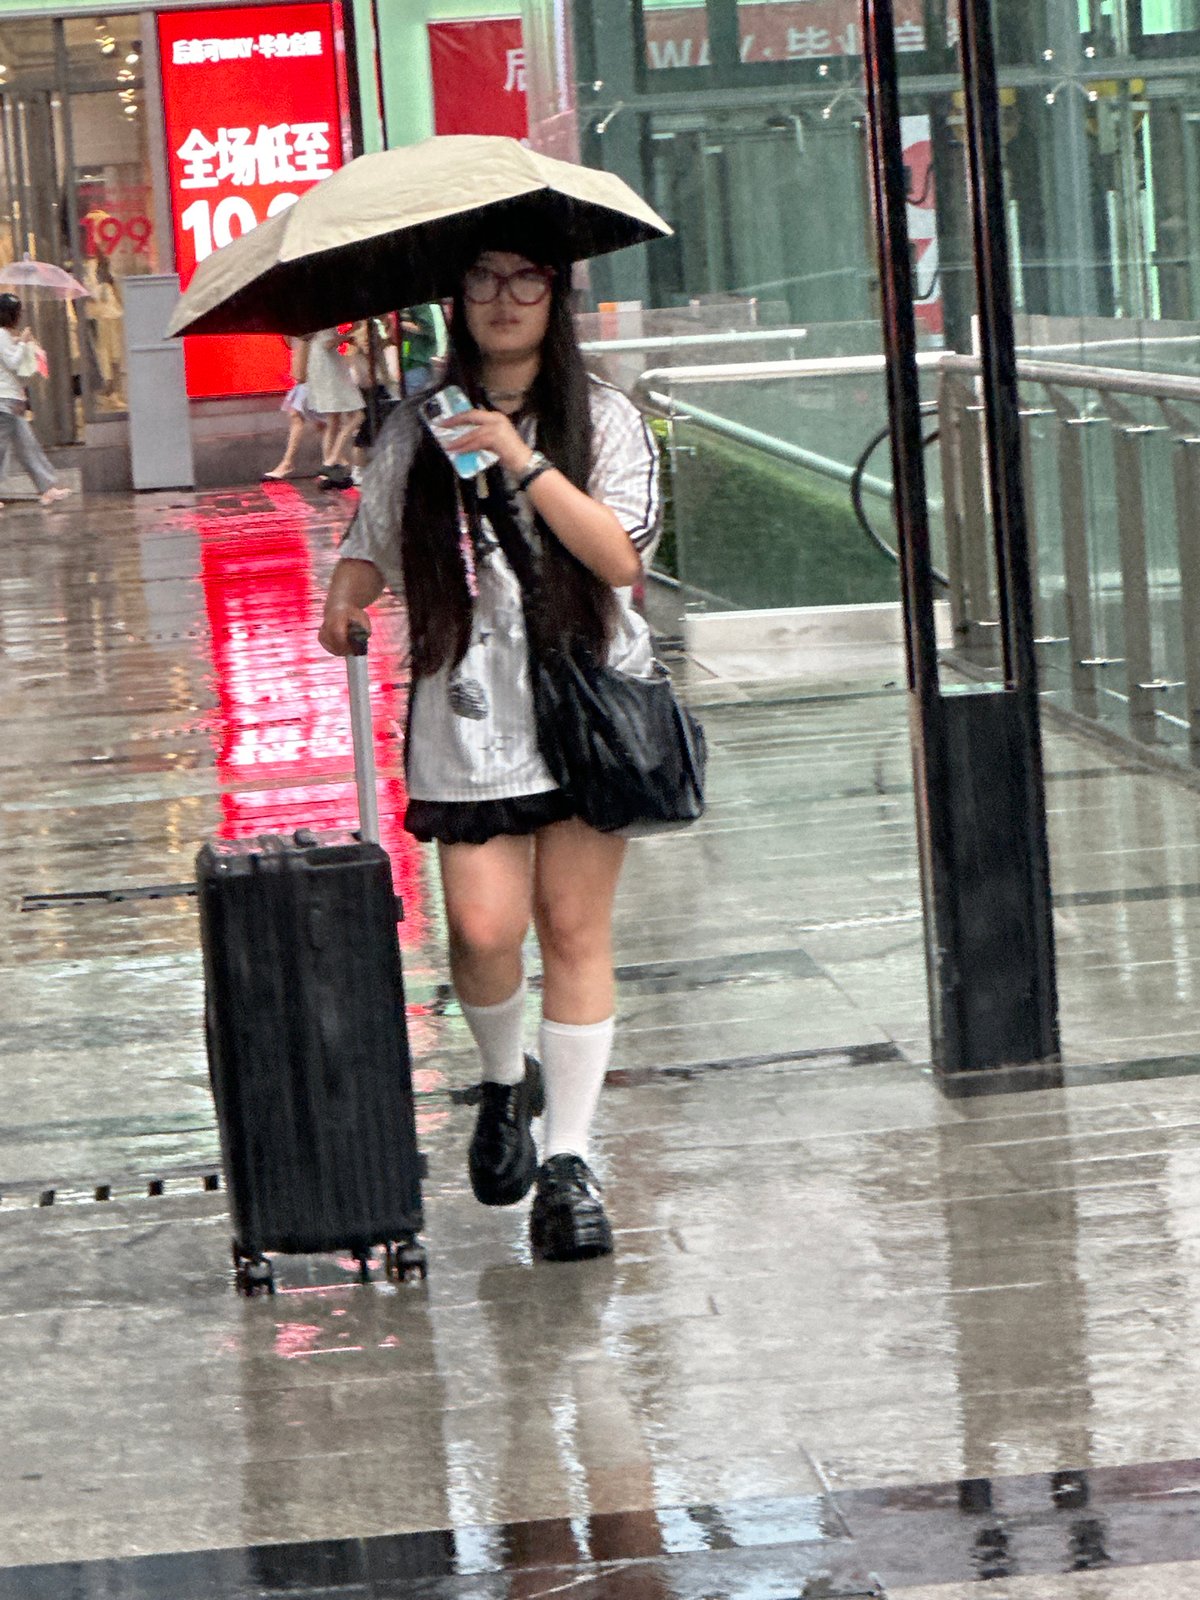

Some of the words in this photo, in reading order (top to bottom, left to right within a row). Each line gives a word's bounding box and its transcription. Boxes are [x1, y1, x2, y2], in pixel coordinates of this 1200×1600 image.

[176, 122, 334, 189] 全场低至
[178, 192, 299, 262] 10
